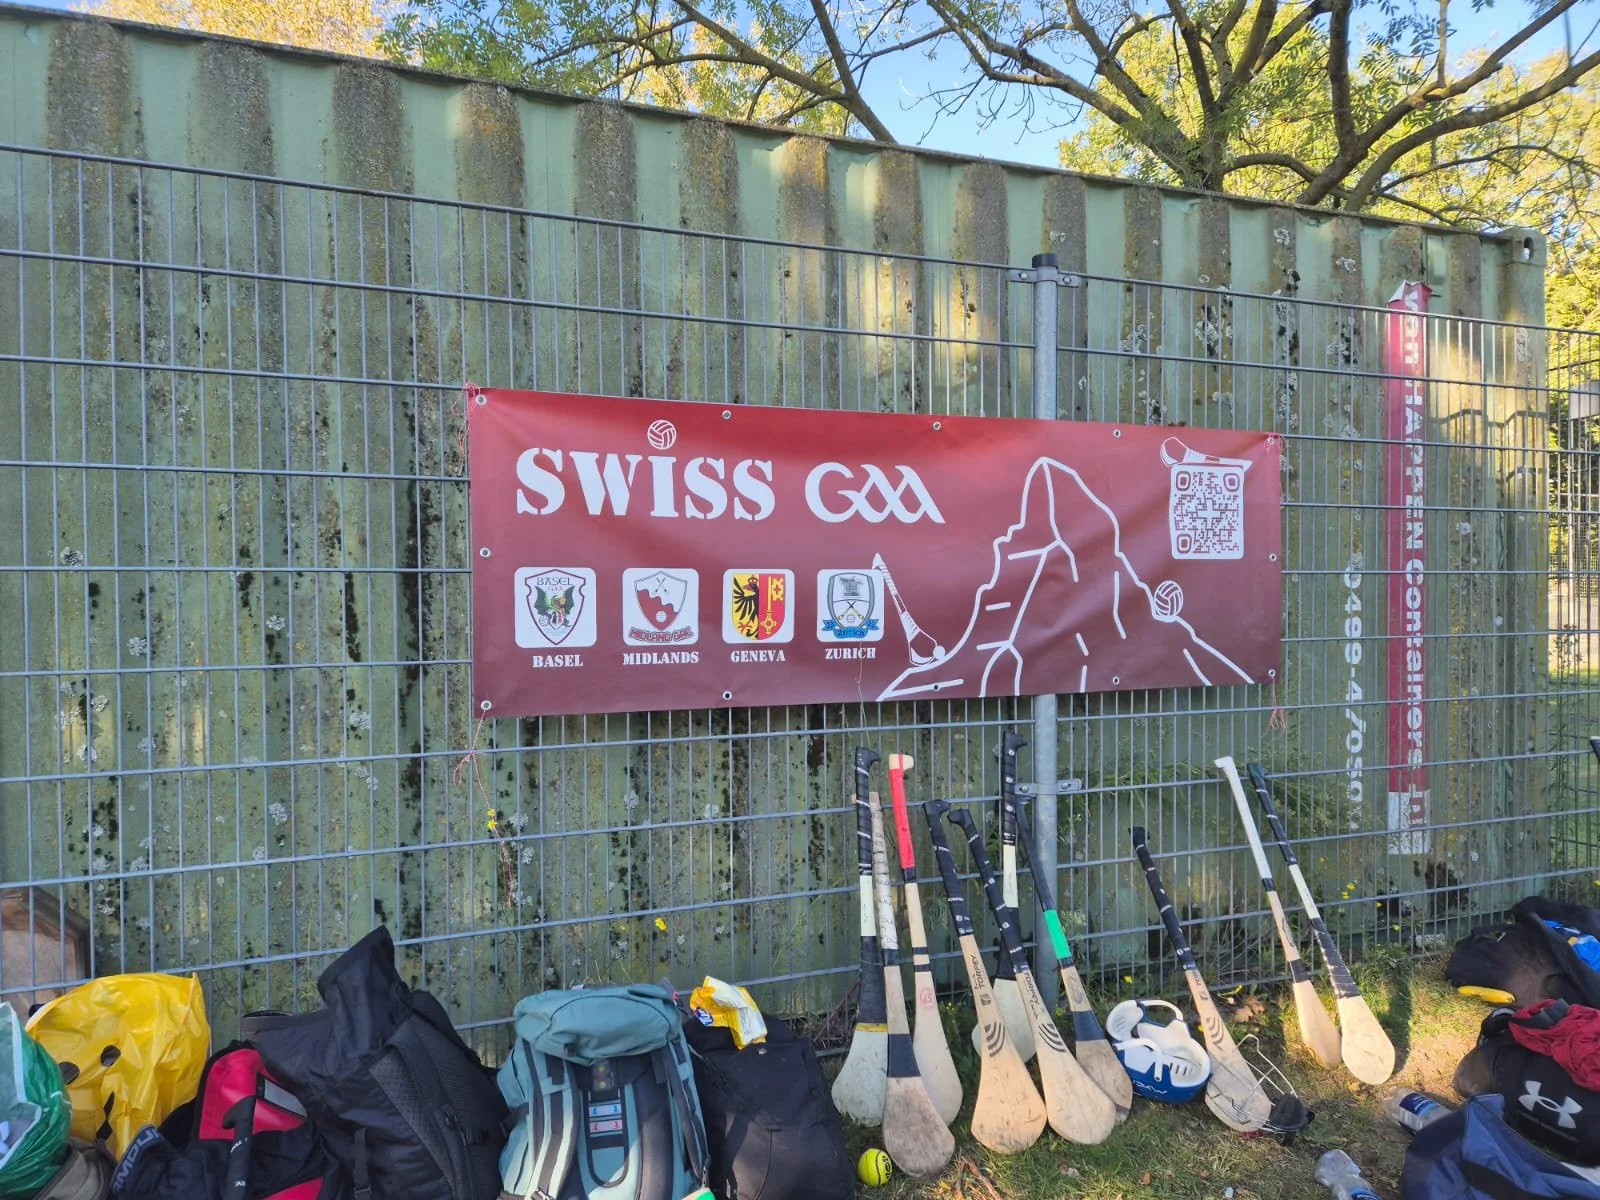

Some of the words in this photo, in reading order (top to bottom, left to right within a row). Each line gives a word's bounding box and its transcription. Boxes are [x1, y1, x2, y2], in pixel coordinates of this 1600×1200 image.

[1404, 379, 1424, 549] HAPPEN
[516, 447, 776, 521] SWISS
[804, 462, 946, 523] GAA
[537, 577, 573, 586] BASEL
[622, 651, 699, 665] MIDLANDS
[730, 649, 786, 663] GENEVA
[825, 647, 876, 659] ZURICH
[532, 654, 583, 668] BASEL
